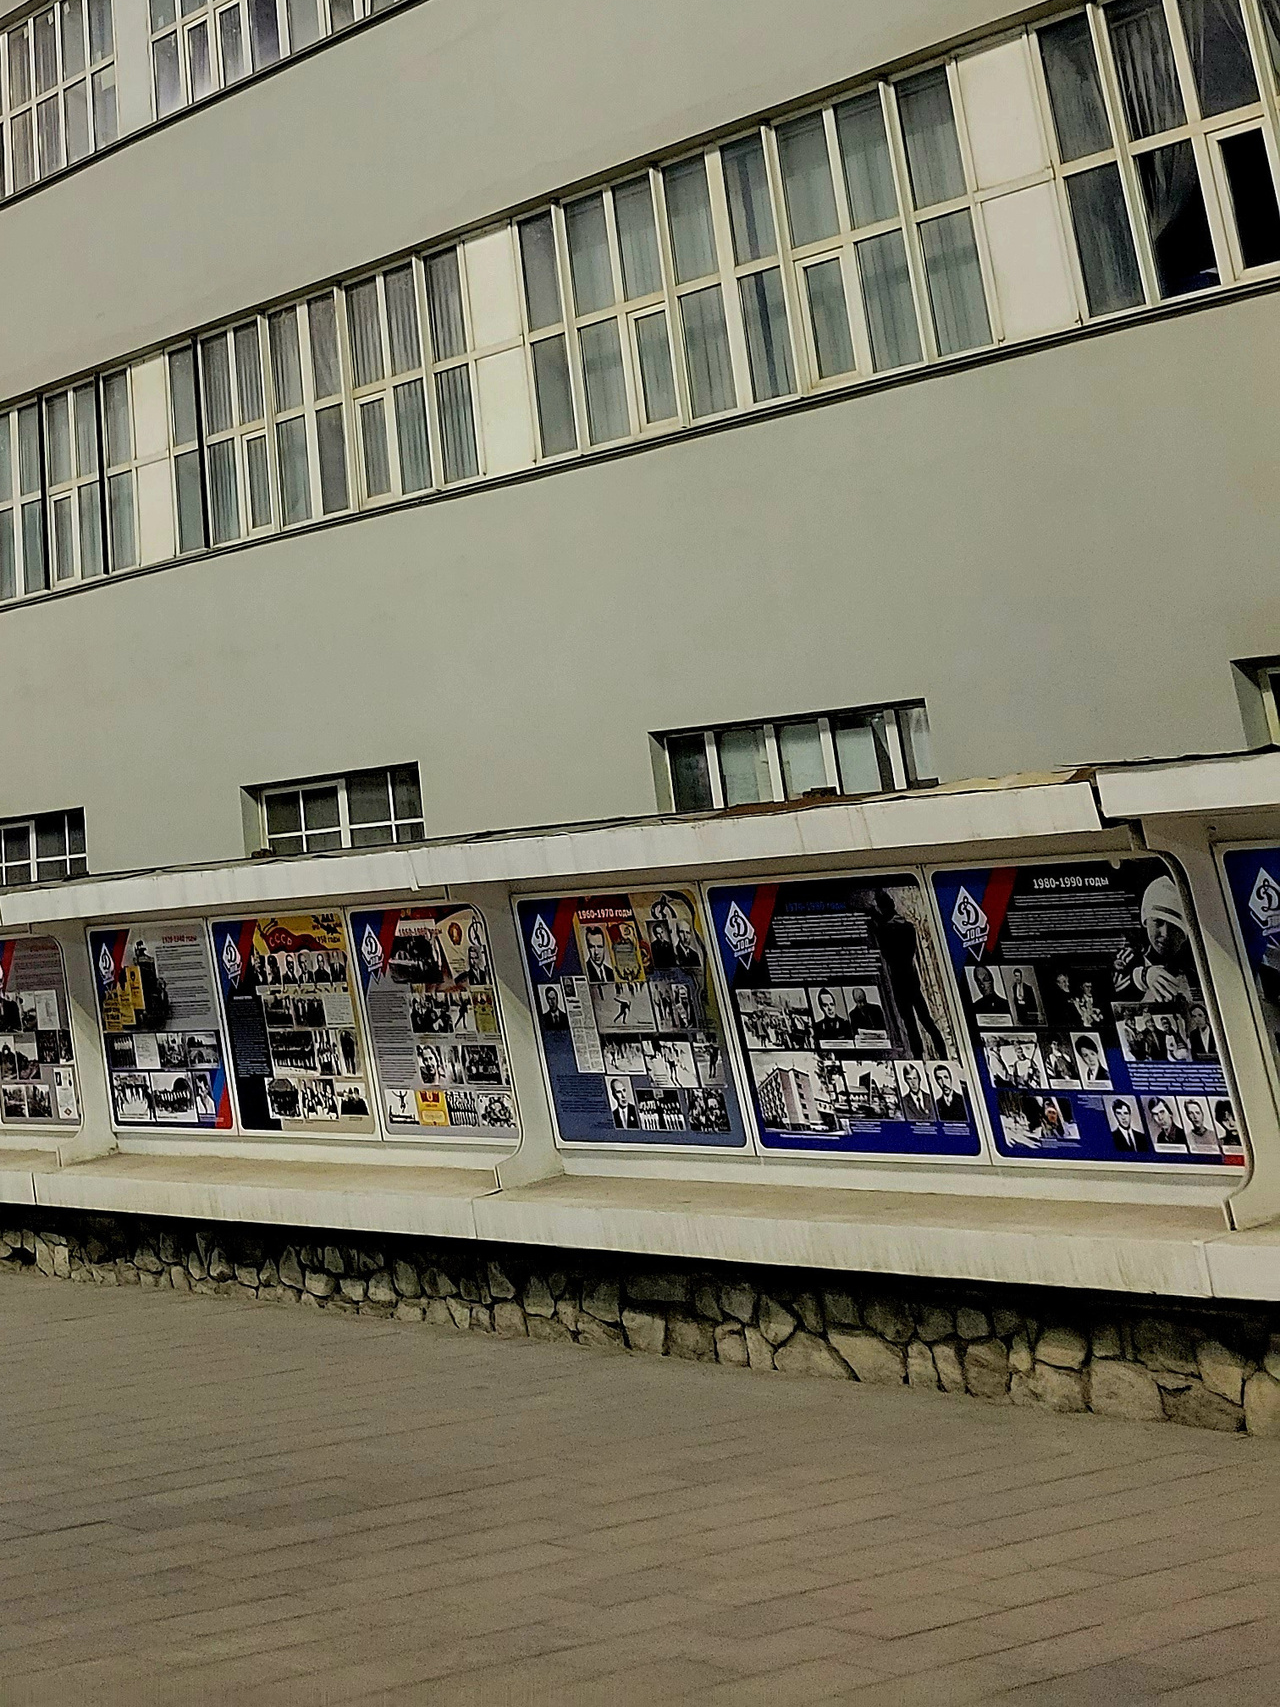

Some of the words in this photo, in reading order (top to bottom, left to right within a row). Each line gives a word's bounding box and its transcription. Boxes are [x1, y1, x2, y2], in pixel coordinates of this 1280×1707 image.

[1033, 877, 1082, 889] 1980-1990
[1085, 876, 1109, 887] годы
[578, 909, 614, 919] 1960-1970
[615, 909, 632, 917] годы
